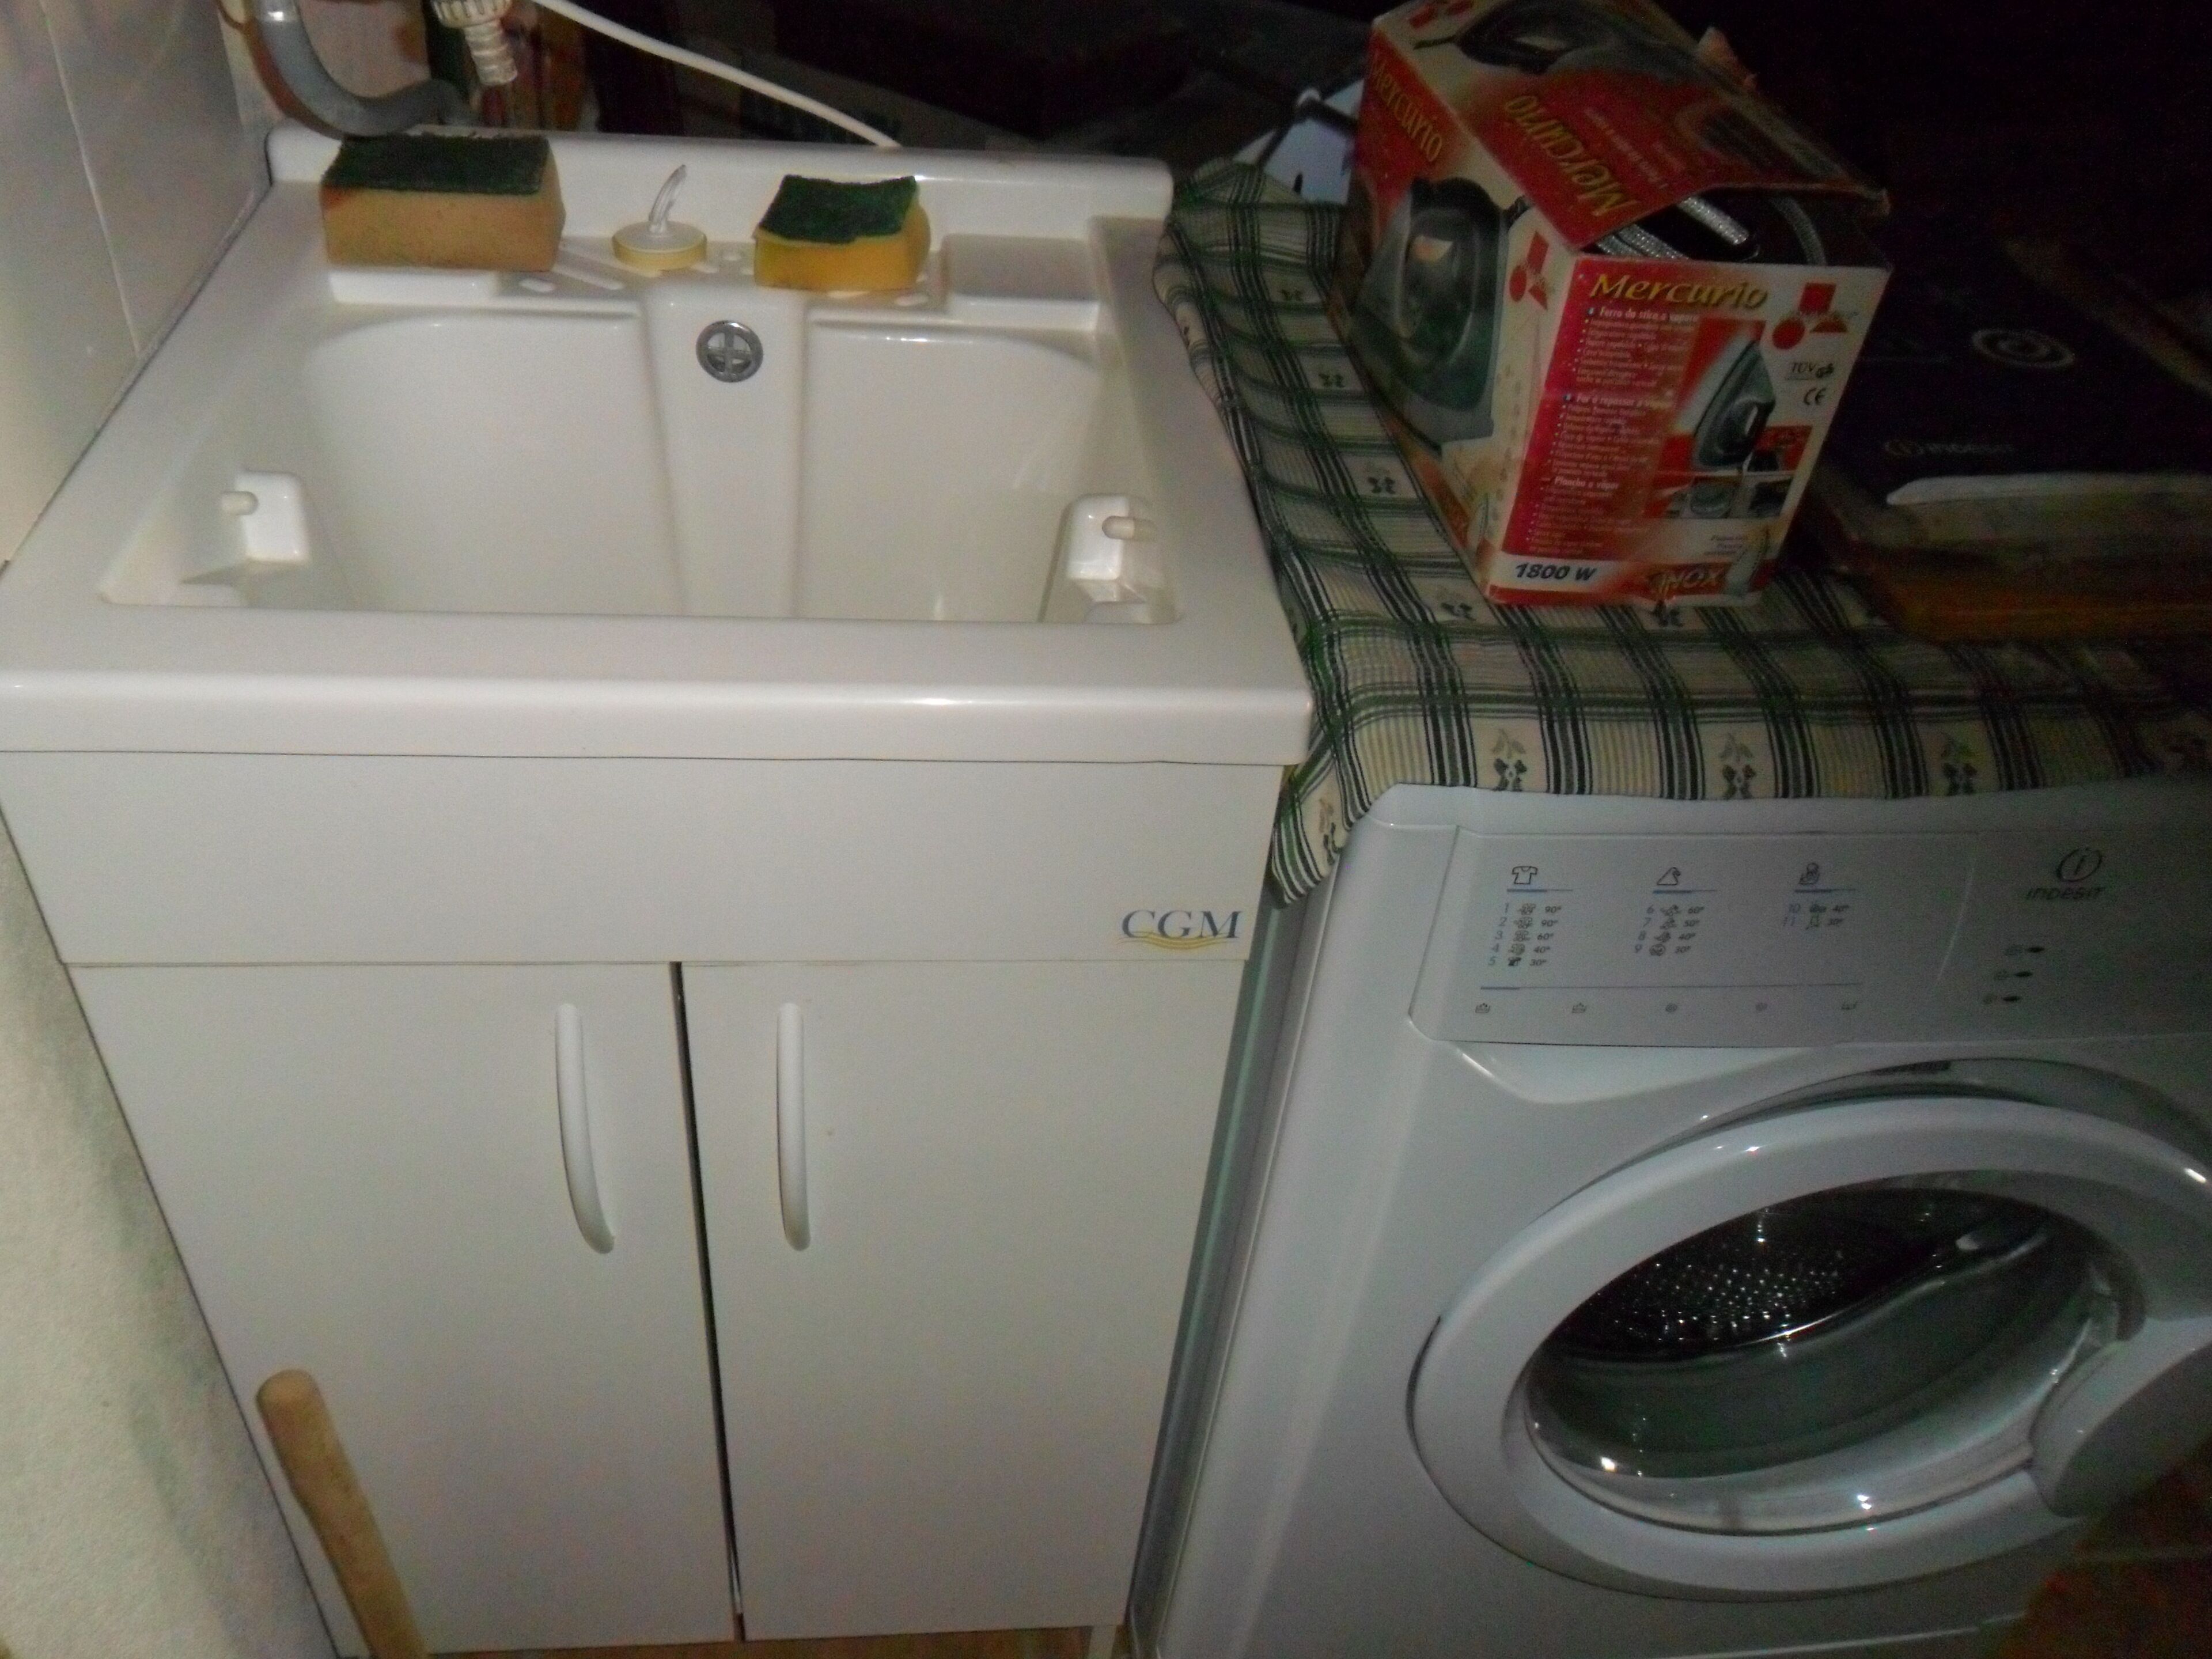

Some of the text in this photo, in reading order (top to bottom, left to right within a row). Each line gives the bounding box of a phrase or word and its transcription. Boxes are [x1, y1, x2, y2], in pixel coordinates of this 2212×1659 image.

[1505, 95, 1641, 217] Mercurio
[1589, 274, 1768, 310] Mercurio
[1803, 387, 1827, 406] CE
[1514, 562, 1597, 581] 1800 W
[1121, 910, 1242, 938] CGM
